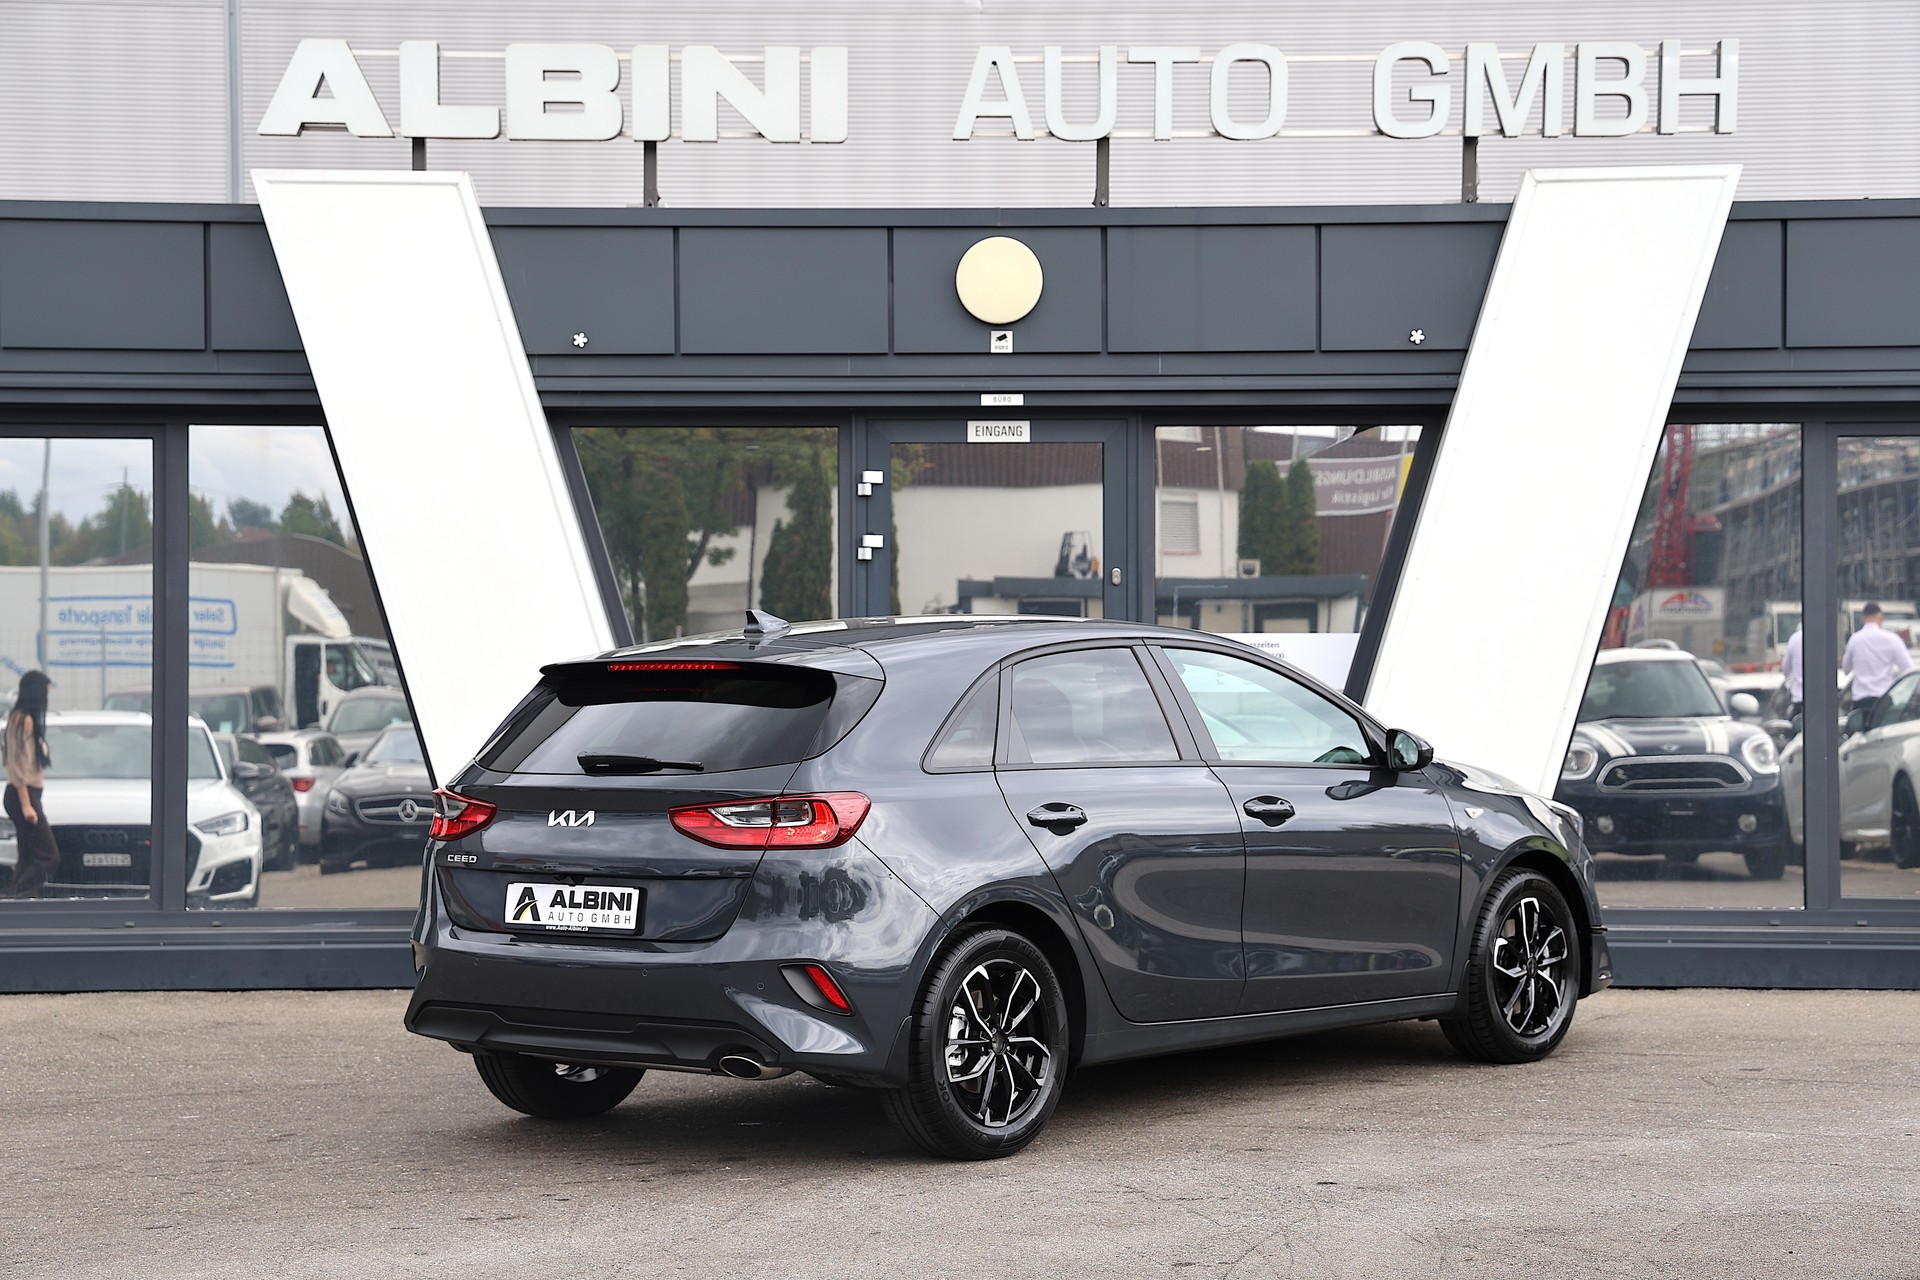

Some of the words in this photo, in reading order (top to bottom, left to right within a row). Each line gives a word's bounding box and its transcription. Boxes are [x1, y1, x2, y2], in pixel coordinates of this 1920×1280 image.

[257, 39, 848, 143] ALBINI
[953, 43, 1288, 142] AUTO
[1372, 40, 1740, 140] GMBH
[975, 425, 1023, 437] EINGANG
[547, 809, 596, 827] KIA
[447, 854, 477, 863] CEED
[549, 889, 633, 911] ALBINI
[548, 912, 584, 922] AUTO
[591, 914, 631, 924] GMBH
